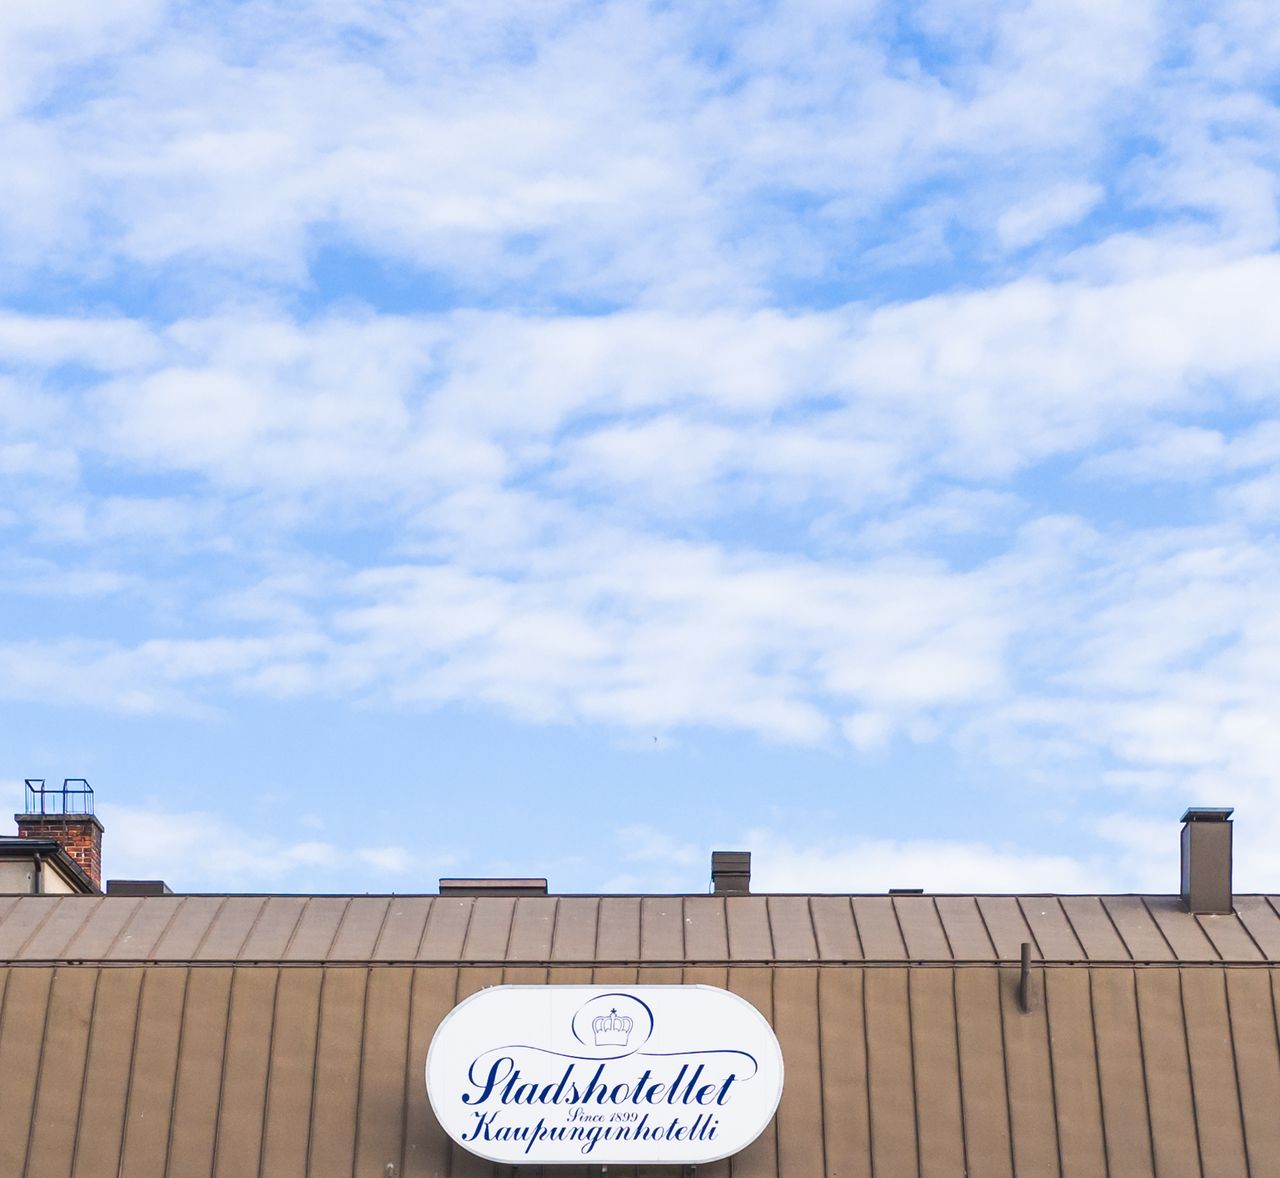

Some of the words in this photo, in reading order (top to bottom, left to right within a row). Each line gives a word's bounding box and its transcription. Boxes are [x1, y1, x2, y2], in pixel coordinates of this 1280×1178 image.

[461, 1056, 737, 1106] Stadshotellet
[461, 1109, 720, 1154] Kaupunginhotelli
[566, 1106, 606, 1123] Since
[609, 1111, 639, 1123] 1899
